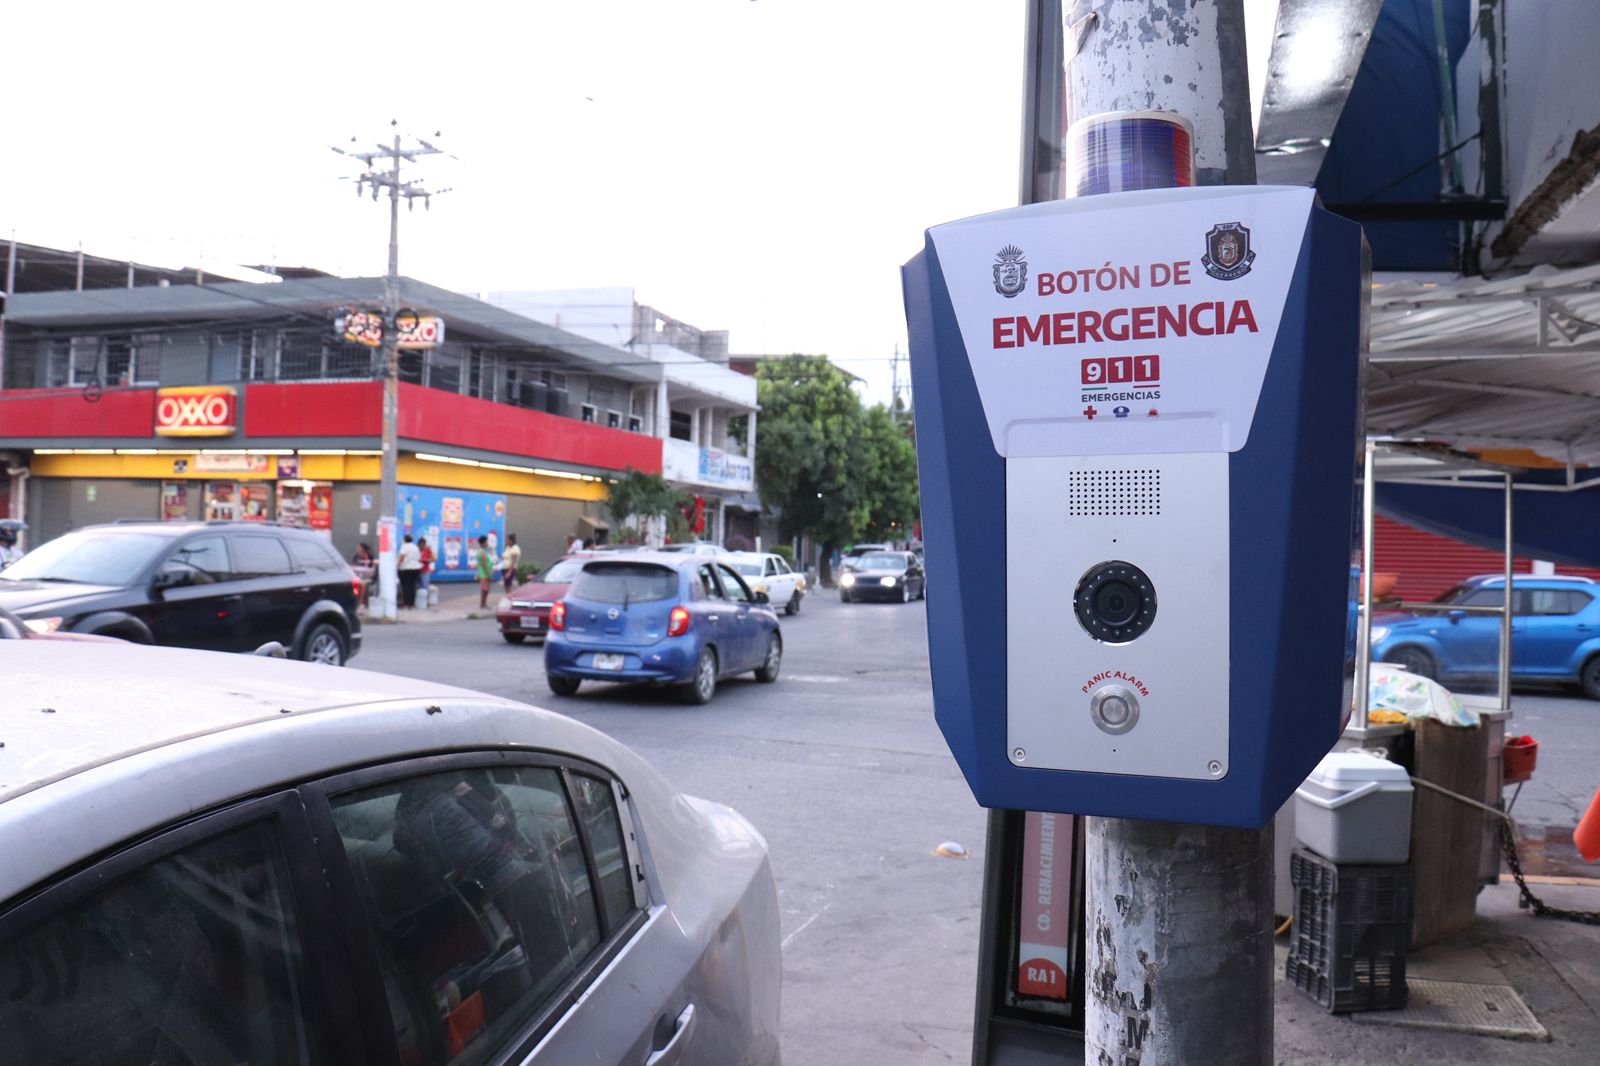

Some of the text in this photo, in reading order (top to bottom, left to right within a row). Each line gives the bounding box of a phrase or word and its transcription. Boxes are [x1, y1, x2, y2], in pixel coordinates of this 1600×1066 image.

[1037, 260, 1192, 297] BOTÓN DE
[992, 299, 1259, 349] EMERGENCIA
[1086, 358, 1152, 382] 911
[158, 394, 229, 427] OXXO
[1081, 390, 1161, 403] EMERGENCIAS
[1081, 670, 1150, 697] PANIC ALARM
